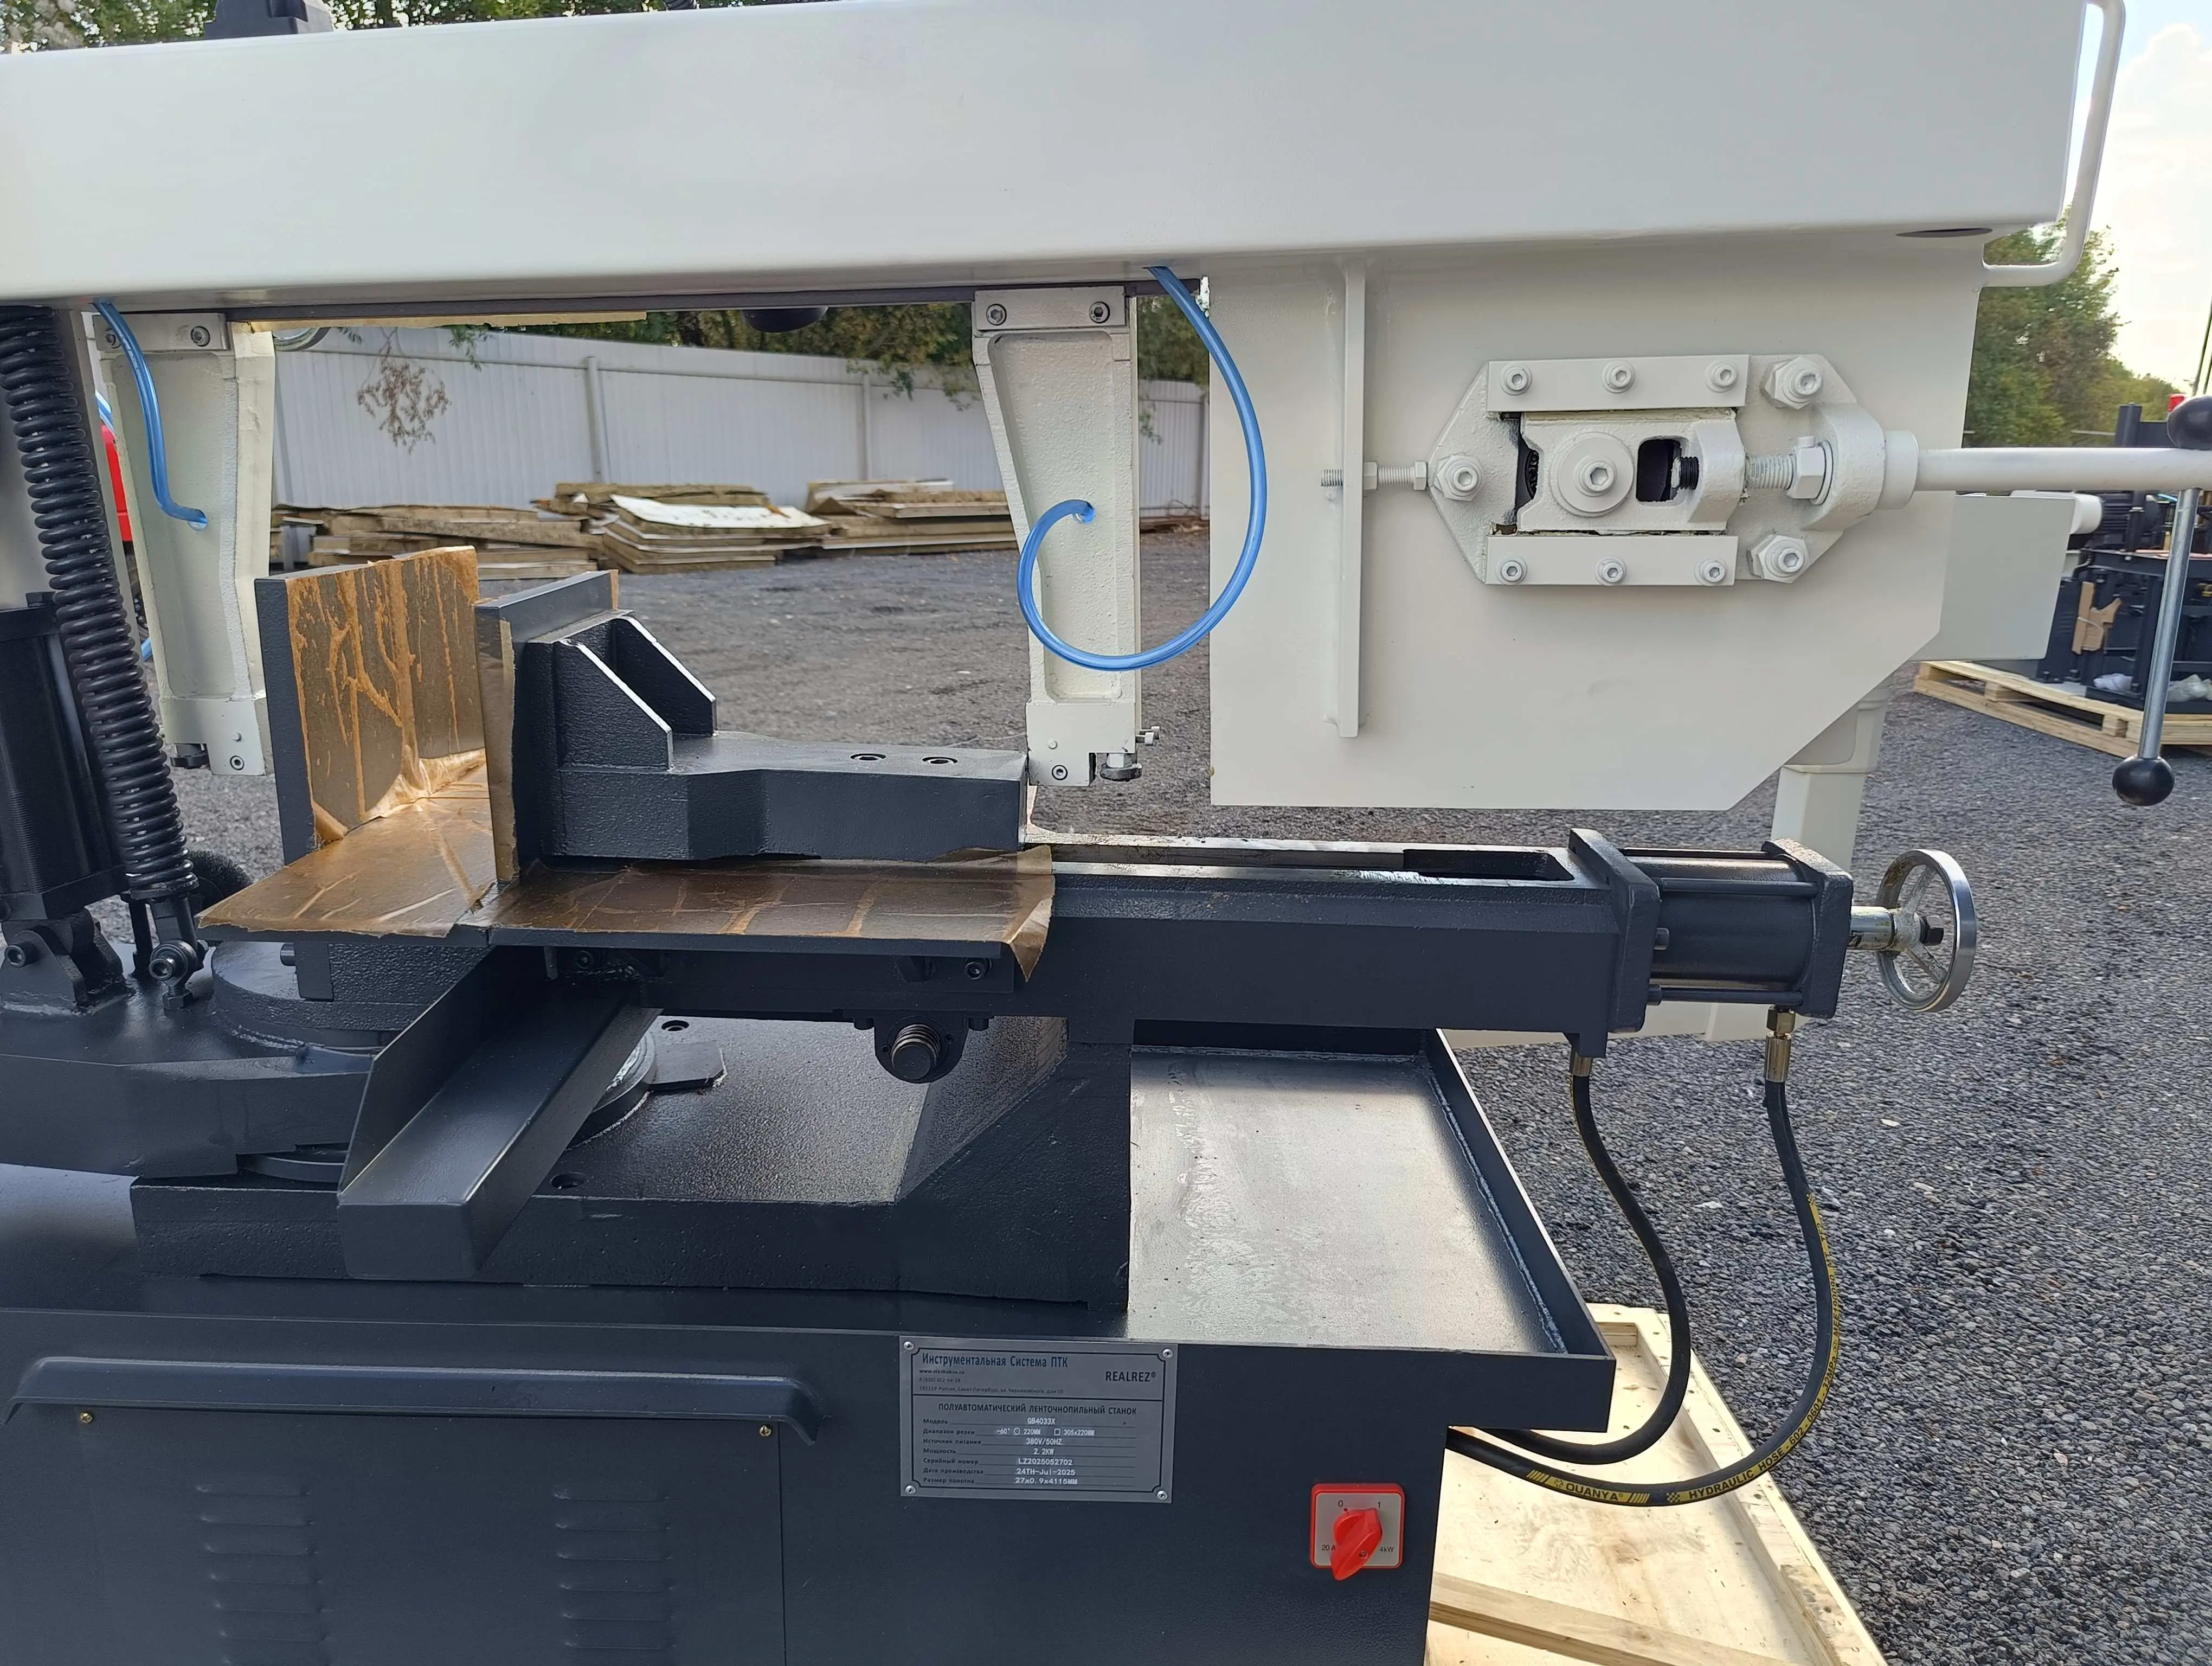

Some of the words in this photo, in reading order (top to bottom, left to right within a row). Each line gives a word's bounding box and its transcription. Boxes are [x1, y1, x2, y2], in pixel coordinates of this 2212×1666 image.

[922, 1353, 1006, 1367] Инструментальная
[1011, 1355, 1047, 1367] Система
[1051, 1356, 1069, 1368] ПТК
[938, 1403, 1026, 1412] ПОЛУАВТОМАТИЧЕСКИЙ
[1028, 1405, 1105, 1414] ЛЕНТОЧНОПИЛЬНЫЙ
[1108, 1407, 1136, 1415] СТАНОК
[1688, 1470, 1754, 1500] HYDRAULIC
[1758, 1450, 1785, 1472] HOSE
[1789, 1427, 1804, 1445] 602
[1806, 1398, 1822, 1422] 0601
[1822, 1356, 1836, 1391] 32MPa
